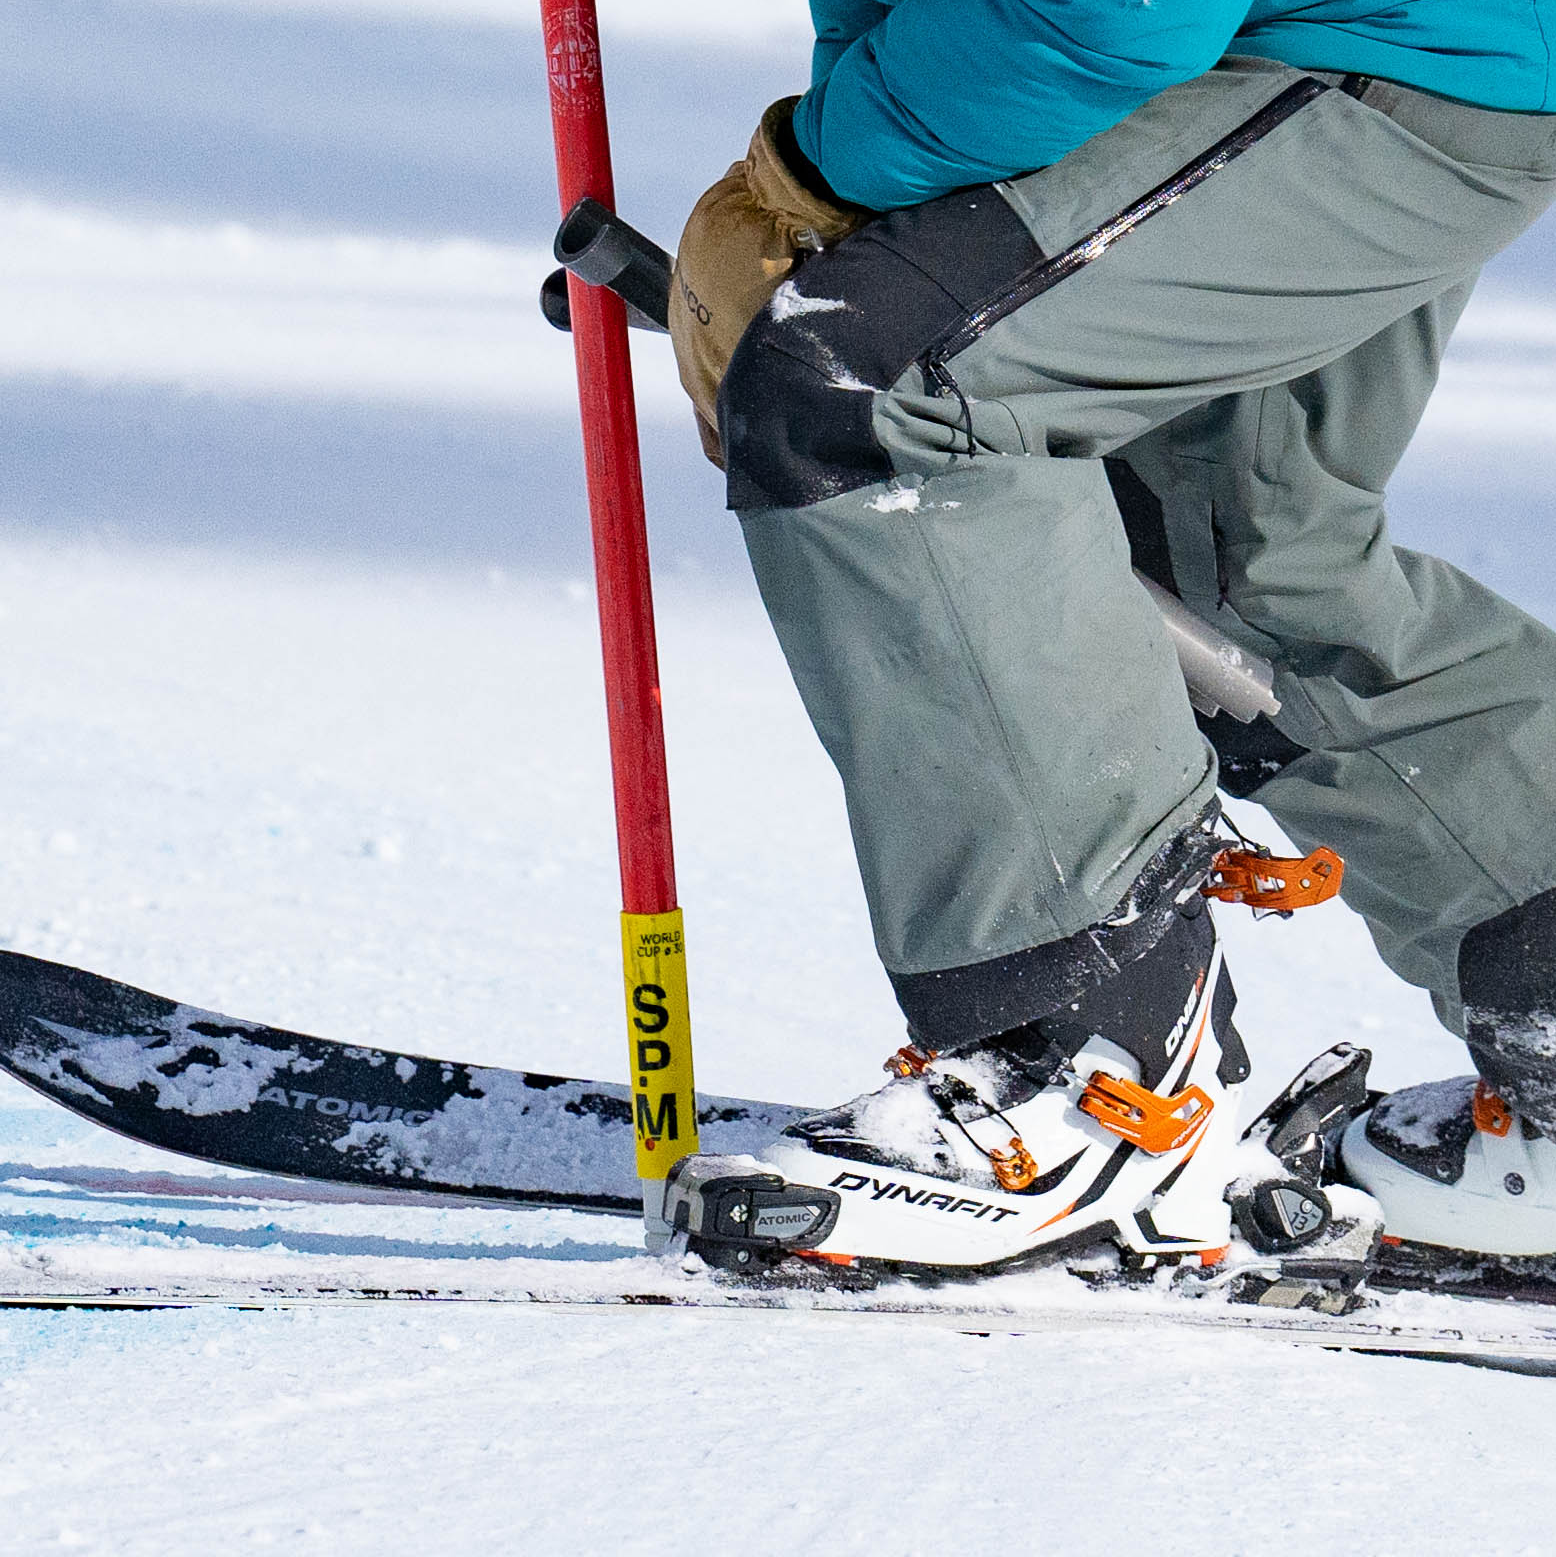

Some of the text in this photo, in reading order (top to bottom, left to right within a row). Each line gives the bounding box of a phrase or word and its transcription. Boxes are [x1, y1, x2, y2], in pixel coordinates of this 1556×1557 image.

[637, 946, 660, 957] CUP
[640, 930, 681, 945] WORLD
[632, 984, 679, 1141] SPM
[258, 1086, 434, 1127] ATOMIC
[827, 1171, 1021, 1222] DYNAFIT
[758, 1212, 811, 1226] ATOMIC
